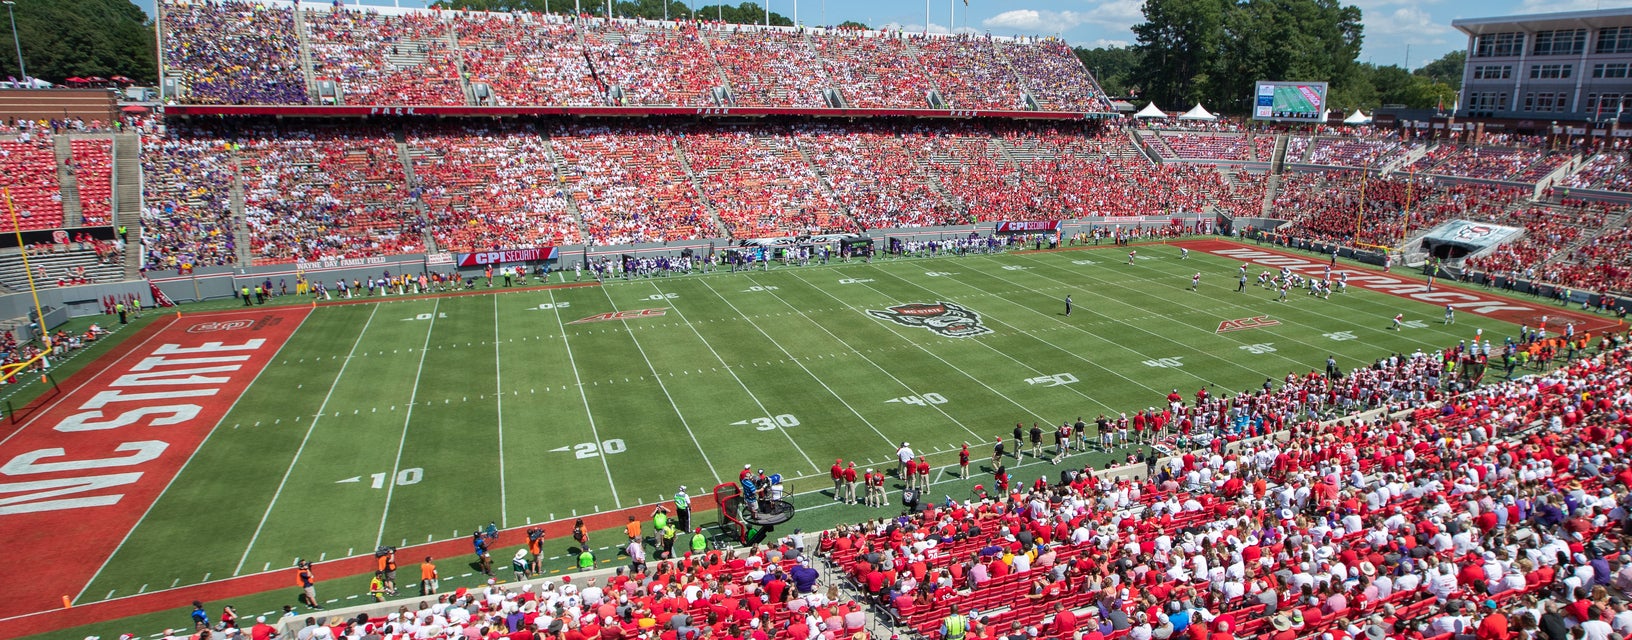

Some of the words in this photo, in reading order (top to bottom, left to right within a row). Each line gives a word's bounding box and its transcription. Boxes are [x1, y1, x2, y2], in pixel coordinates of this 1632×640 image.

[371, 107, 414, 115] PACK
[1008, 221, 1028, 230] CPI
[296, 262, 322, 270] WAYNE
[324, 260, 338, 268] DAY
[341, 258, 365, 266] FAMILY
[367, 256, 386, 264] FIELD
[475, 252, 507, 264] CPI
[506, 249, 541, 262] SECURITY
[1210, 249, 1535, 314] WOLFPACK
[1215, 314, 1283, 334] ACC
[53, 337, 267, 433] STATE
[901, 392, 949, 406] 40
[751, 412, 801, 432] 30
[574, 438, 627, 461] 20
[0, 439, 171, 516] NC
[371, 466, 424, 490] 10
